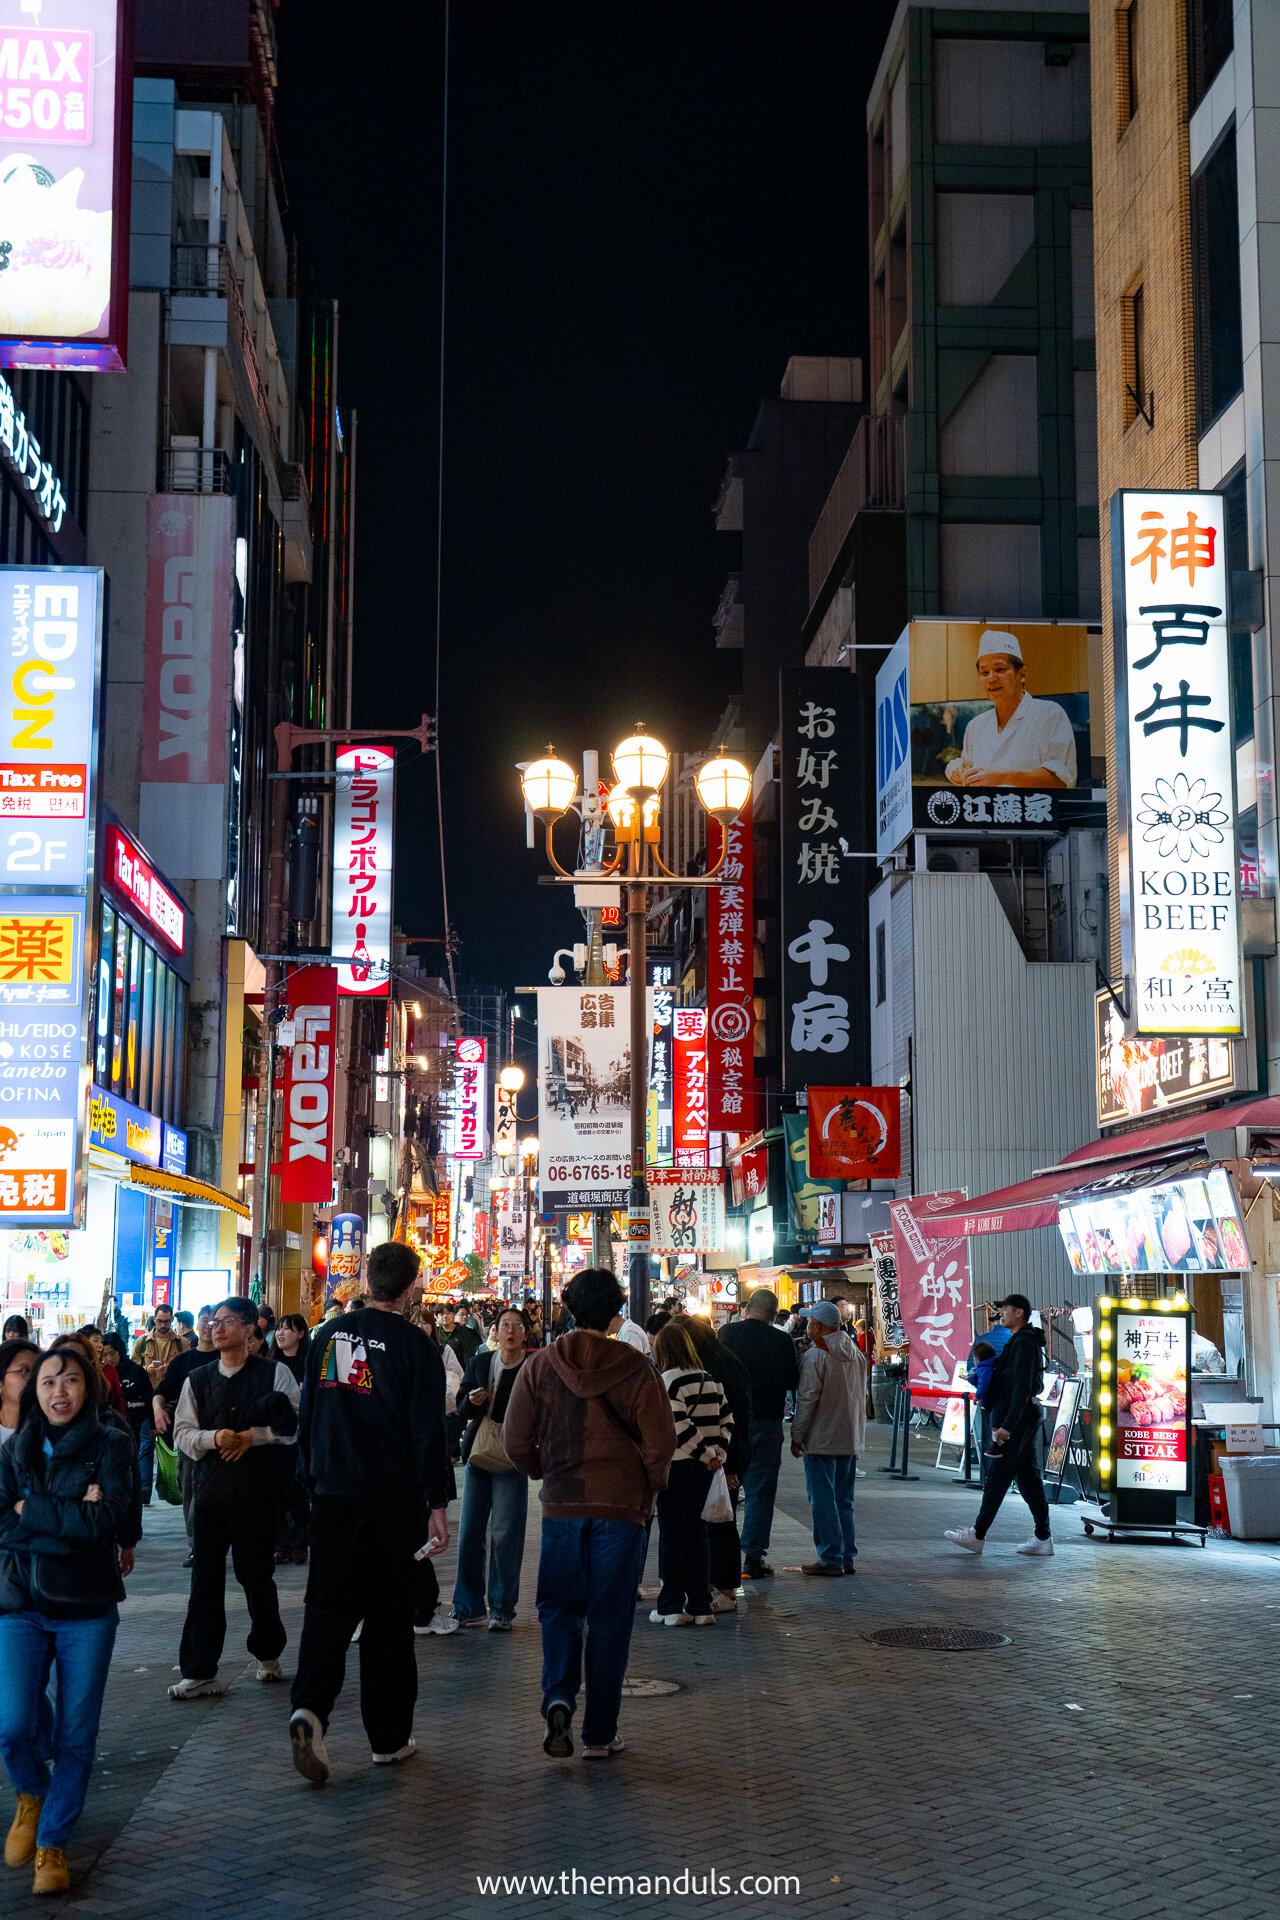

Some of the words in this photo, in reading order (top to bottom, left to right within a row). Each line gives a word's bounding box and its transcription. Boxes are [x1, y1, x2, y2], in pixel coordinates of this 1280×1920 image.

[0, 87, 61, 130] 50
[11, 584, 32, 656] エディオン
[1130, 510, 1226, 757] 神戸牛
[11, 585, 79, 749] EDION
[0, 770, 36, 787] Tax
[40, 770, 83, 788] Free
[2, 796, 31, 811] 免税
[49, 797, 79, 812] 면세
[797, 702, 841, 885] お好み焼
[962, 793, 1053, 824] 江藤家
[348, 755, 380, 919] ドラゴンボウル
[6, 831, 68, 872] 2F
[117, 839, 133, 890] Tax
[132, 858, 150, 907] Free
[1139, 870, 1232, 897] KOBE
[717, 807, 745, 993] 名物実弾禁止
[1143, 904, 1229, 931] BEEF
[0, 919, 63, 980] 薬
[788, 919, 851, 1054] 千房
[580, 994, 615, 1011] 広告
[1143, 1002, 1235, 1014] WANOMIYA
[0, 1021, 77, 1038] HISEIDO
[580, 1011, 615, 1029] 募集
[677, 1011, 703, 1037] 薬
[20, 1042, 73, 1058] KOSÉ
[1160, 1047, 1184, 1083] BEEF
[685, 1051, 707, 1127] アカカベ
[460, 1066, 478, 1151] ジャンカラ
[670, 1187, 698, 1248] 射的
[977, 1217, 991, 1233] KOBE
[990, 1215, 1004, 1232] BEEF
[795, 1234, 819, 1242] CHI
[330, 1253, 361, 1265] ドラゴン
[330, 1265, 359, 1275] ボウル
[156, 1282, 167, 1306] Tax
[1124, 1329, 1179, 1350] 神戸牛
[1133, 1350, 1172, 1362] ステーキ
[1124, 1430, 1150, 1440] KOBE
[1152, 1431, 1178, 1441] BEEF
[1124, 1443, 1178, 1459] STEAK
